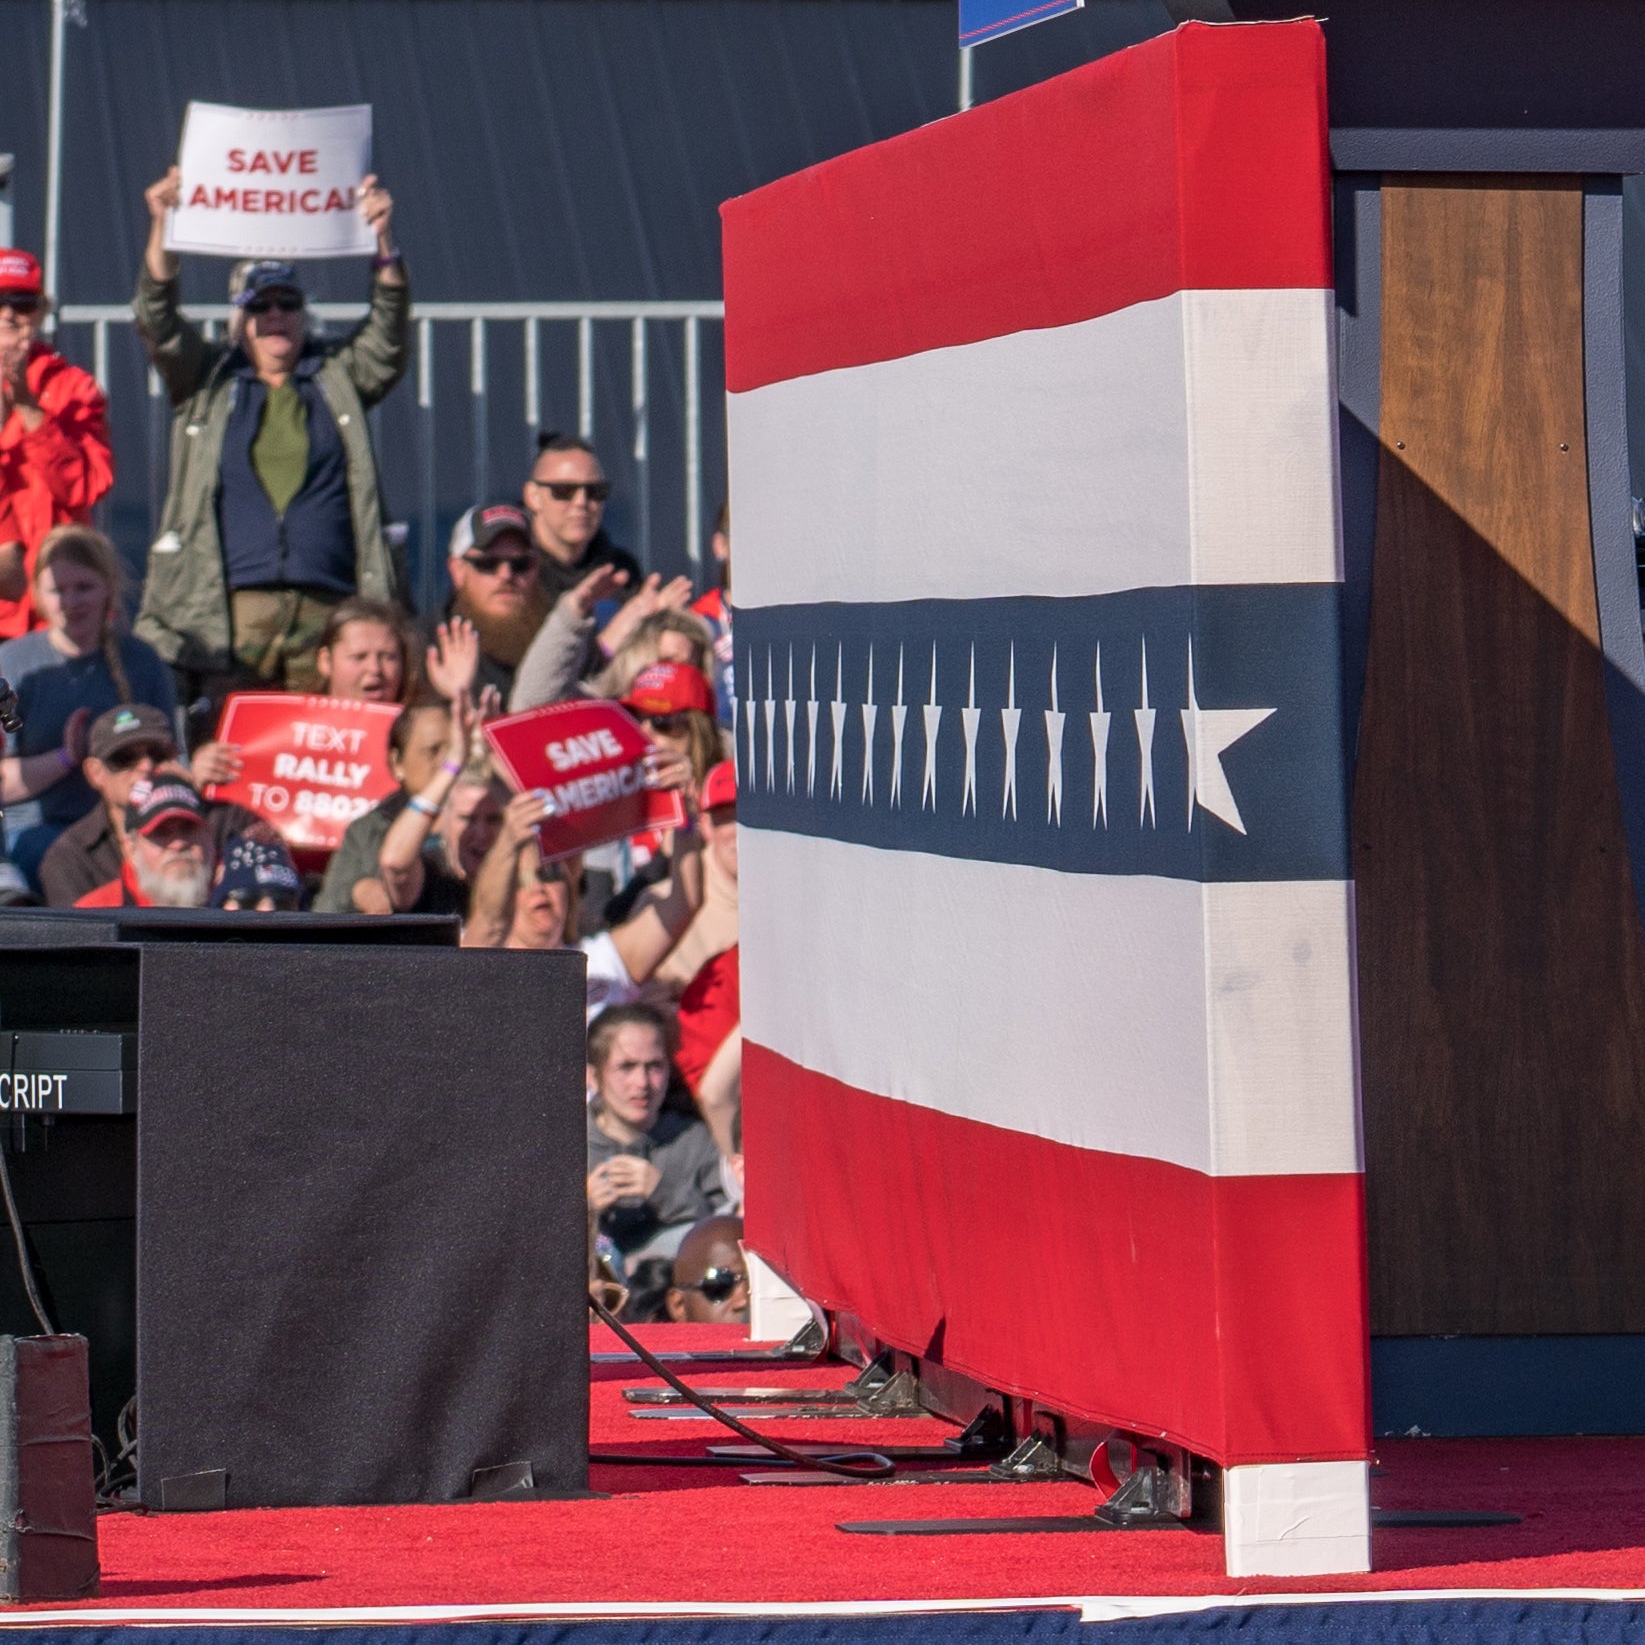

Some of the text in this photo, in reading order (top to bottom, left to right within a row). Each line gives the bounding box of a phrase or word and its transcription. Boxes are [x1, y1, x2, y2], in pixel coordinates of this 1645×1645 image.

[226, 149, 319, 175] SAVE
[290, 720, 368, 755] TEXT
[545, 728, 624, 772] SAVE
[273, 752, 371, 790] RALLY
[248, 782, 290, 812] TO
